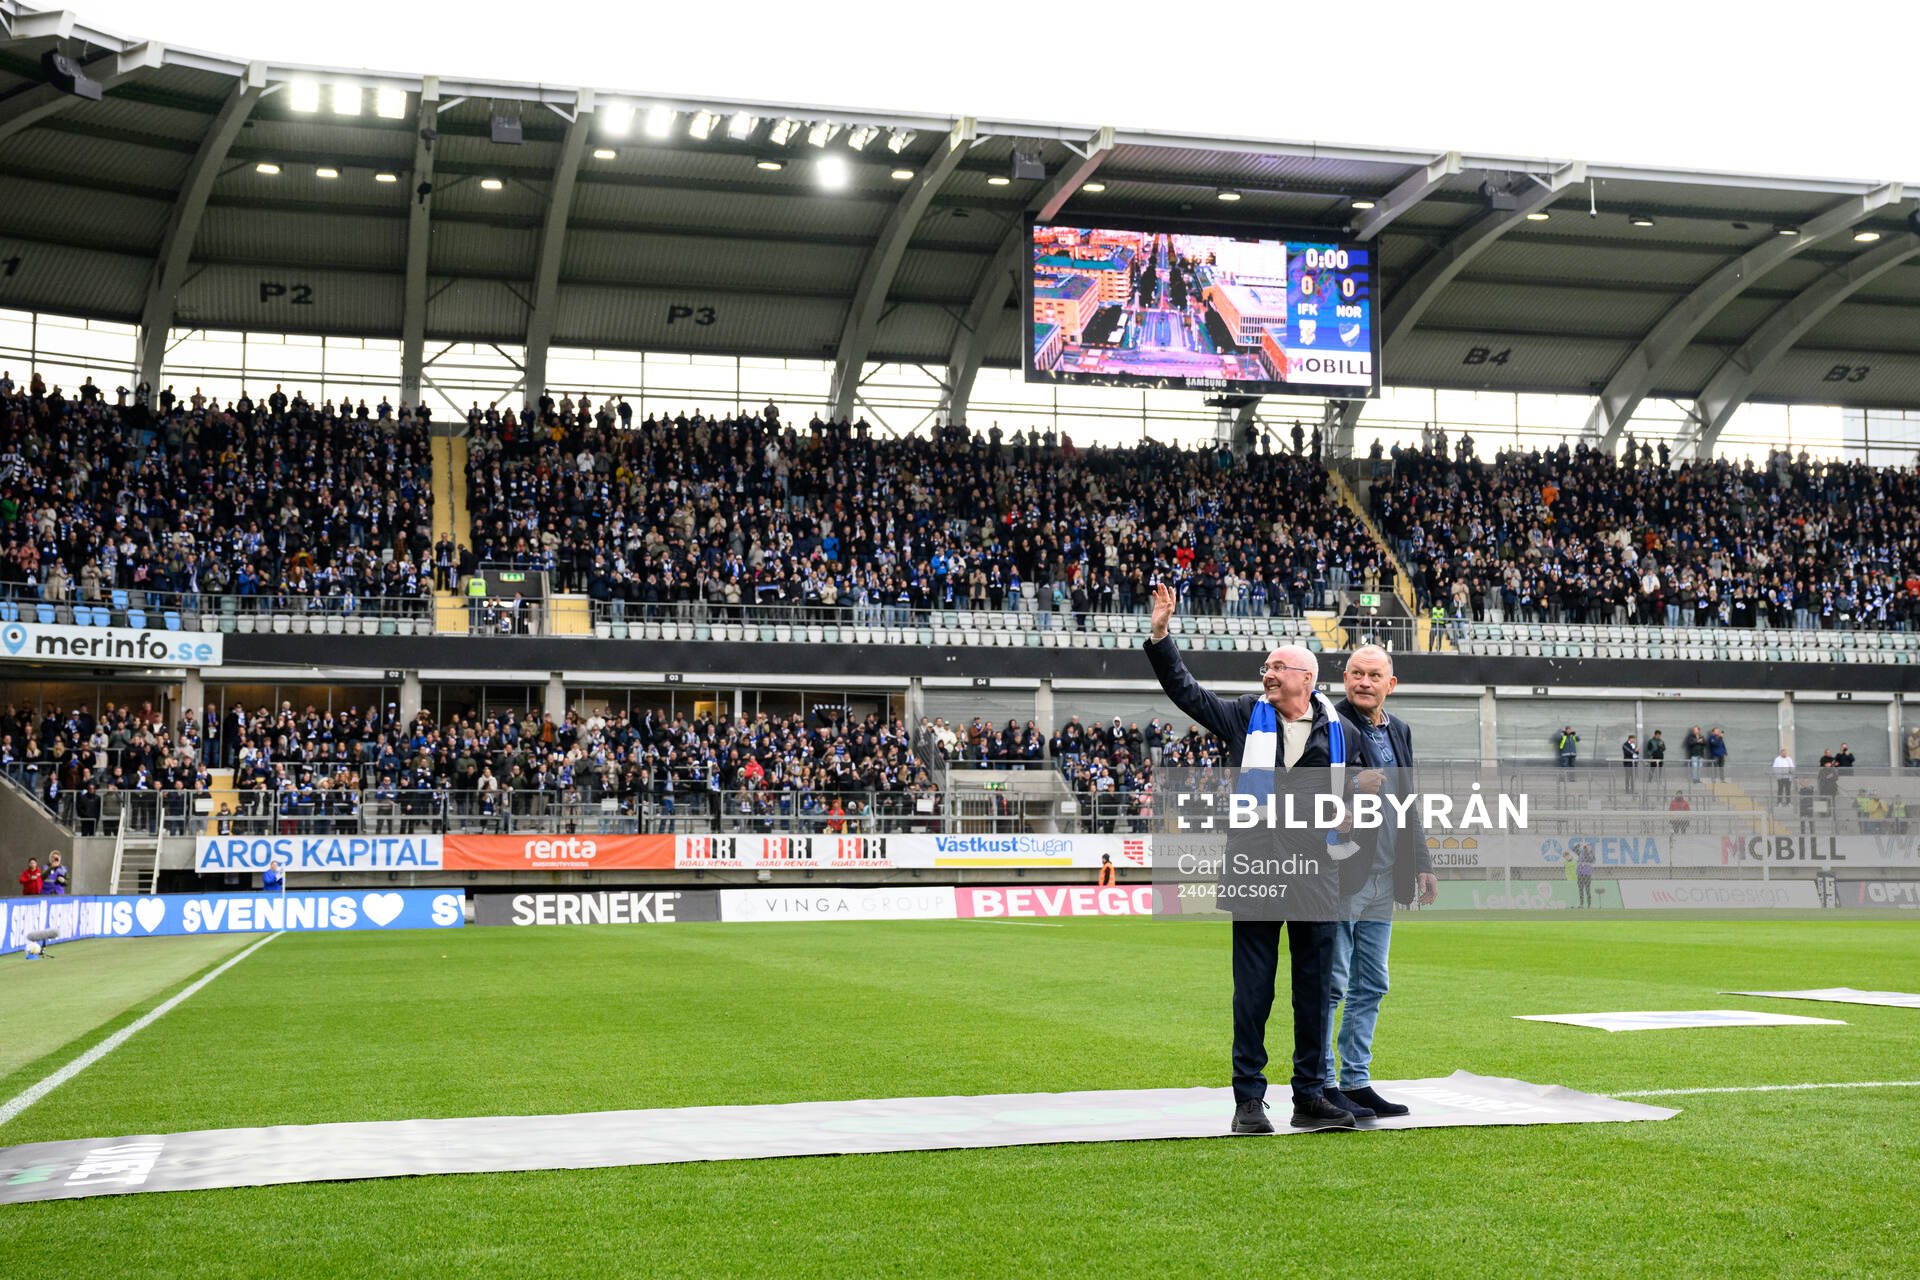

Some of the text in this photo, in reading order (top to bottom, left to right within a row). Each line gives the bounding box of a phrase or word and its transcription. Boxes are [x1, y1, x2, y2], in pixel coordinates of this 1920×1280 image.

[1305, 248, 1348, 269] 0:00
[260, 282, 313, 305] P2
[1301, 275, 1313, 296] 0
[1342, 277, 1355, 299] 0
[667, 305, 716, 325] P3
[1297, 303, 1318, 316] IFK
[1336, 305, 1362, 318] NOR
[1287, 355, 1372, 375] MOBILL
[1462, 347, 1511, 366] B4
[1185, 377, 1228, 388] SAMSUNG
[1822, 366, 1870, 382] B3
[36, 632, 213, 661] merinfo.se
[201, 838, 439, 868] AROS KAPITAL
[525, 837, 597, 859] renta
[935, 835, 1073, 856] VästkustStugan
[1148, 845, 1227, 857] STENFAST
[1721, 836, 1846, 865] MOBILL
[512, 892, 676, 926] SERNEKE
[766, 896, 944, 912] VINGA GROUP
[971, 887, 1164, 918] BEVEGO
[182, 896, 358, 933] SVENNIS
